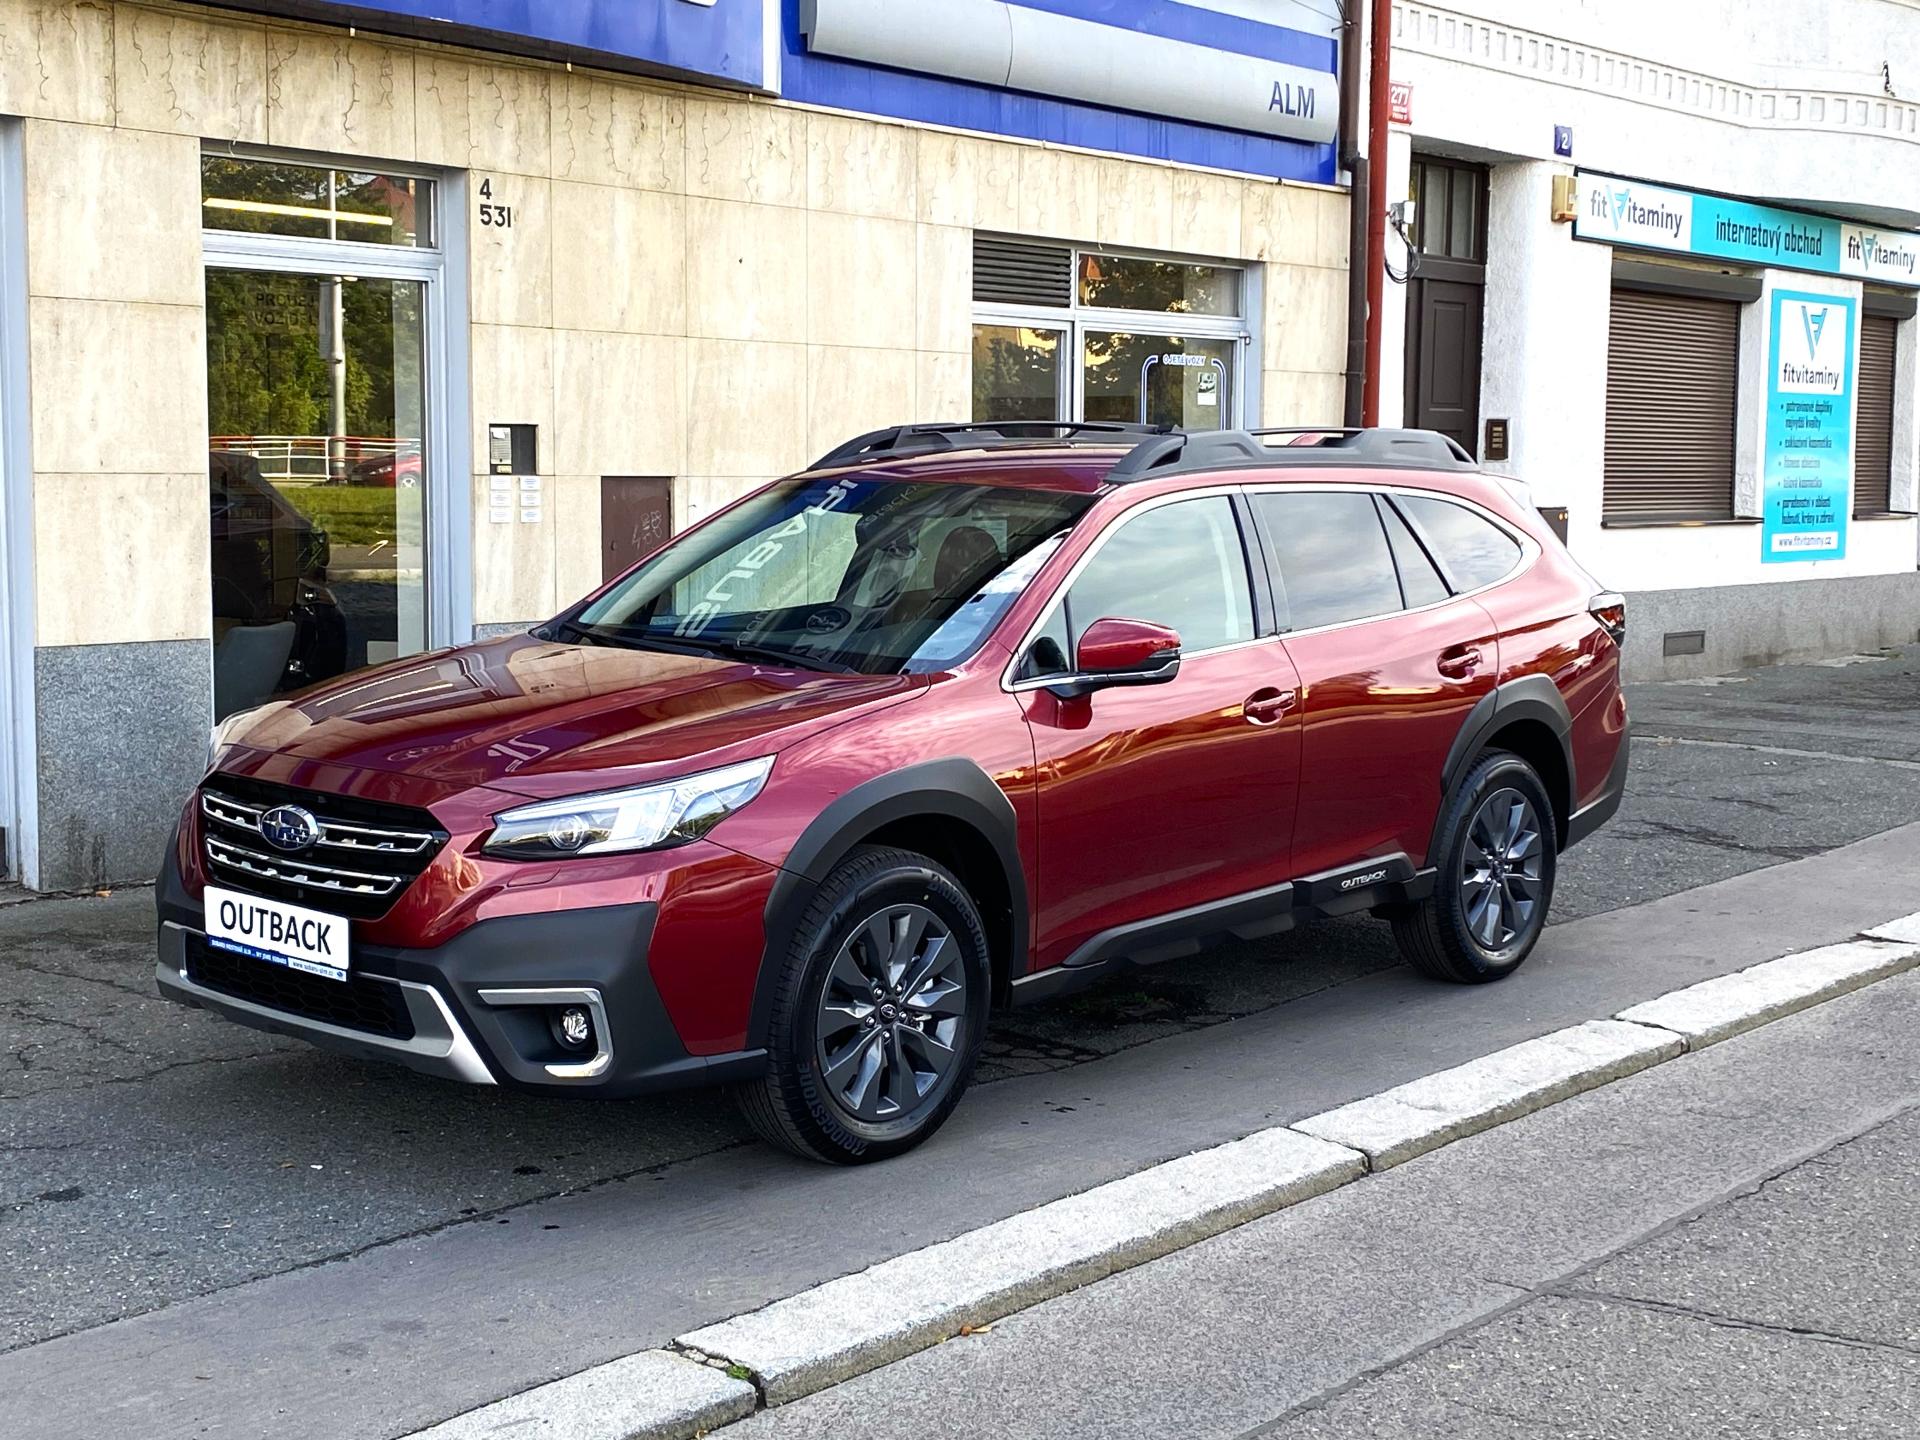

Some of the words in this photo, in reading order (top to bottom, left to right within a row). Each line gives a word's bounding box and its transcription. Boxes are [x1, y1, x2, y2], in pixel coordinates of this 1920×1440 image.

[1269, 81, 1315, 119] ALM
[1391, 86, 1409, 105] 277
[1561, 132, 1569, 150] 2
[479, 178, 492, 200] 4
[480, 204, 511, 228] 531
[1716, 214, 1781, 256] internetový
[1784, 223, 1823, 256] obchod
[1163, 353, 1185, 365] OJETÉ
[1186, 356, 1206, 366] VOZY
[1783, 363, 1839, 391] fitvitaminy
[1341, 870, 1387, 888] OUTBACK
[220, 900, 331, 955] OUTBACK
